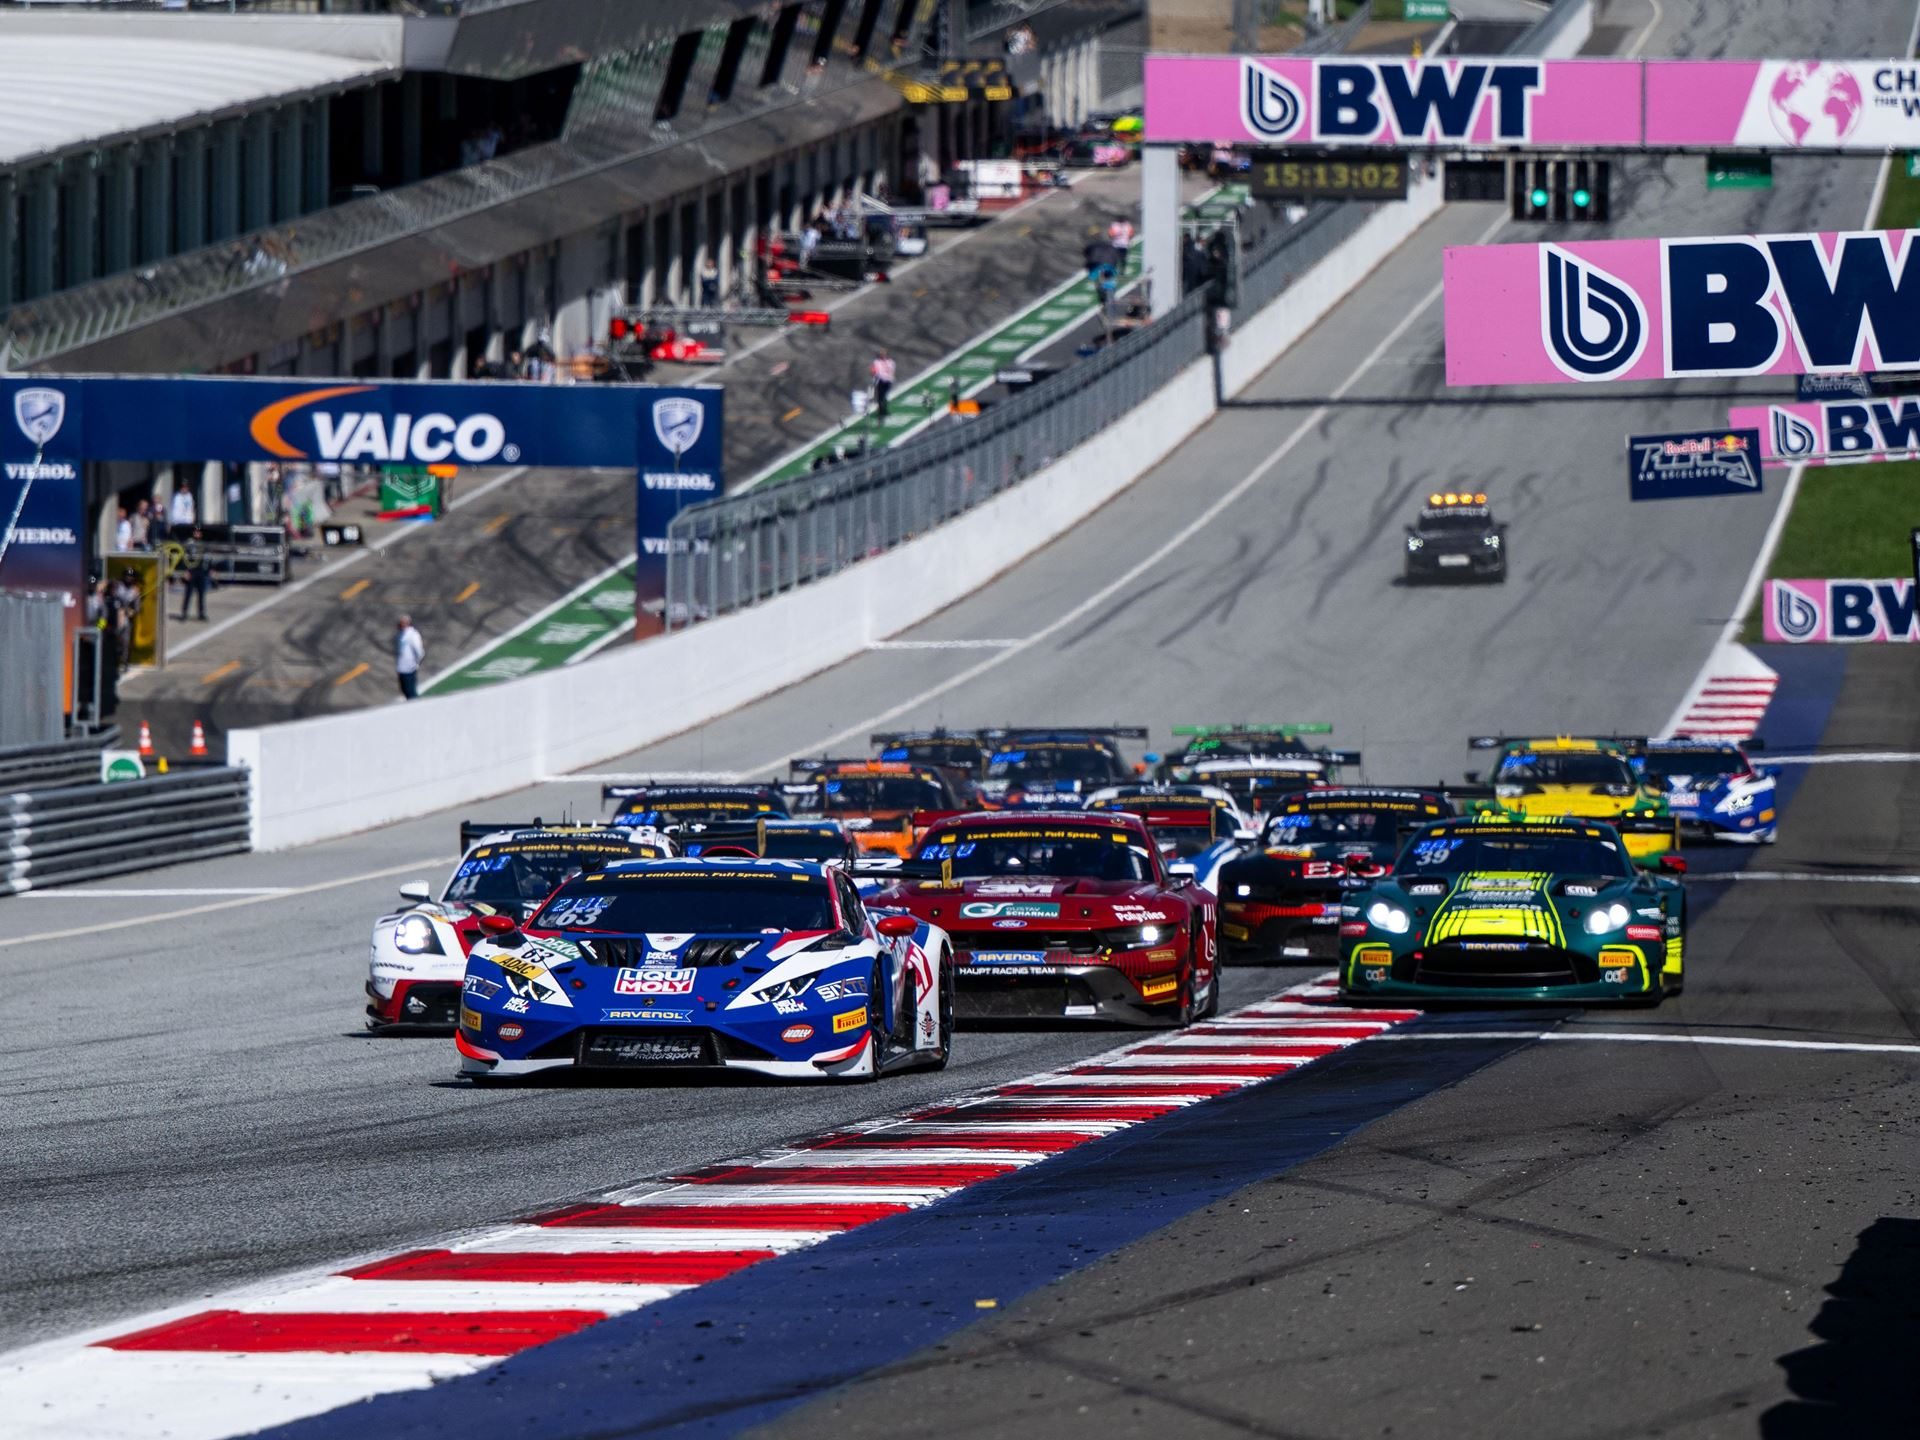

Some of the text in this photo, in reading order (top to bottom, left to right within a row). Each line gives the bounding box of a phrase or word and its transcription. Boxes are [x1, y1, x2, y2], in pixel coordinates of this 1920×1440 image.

[1873, 69, 1920, 92] CH
[1316, 61, 1543, 141] BWT
[1263, 163, 1400, 189] 15:13:02
[5, 464, 76, 480] VIEROL
[643, 473, 715, 490] VIEROL
[5, 528, 76, 544] VIEROL
[1415, 848, 1450, 866] 39
[736, 871, 777, 879] Speed.
[555, 907, 603, 925] 63
[520, 947, 555, 963] 63
[542, 937, 582, 959] DEKRA
[499, 956, 536, 974] ADAC
[977, 952, 1040, 962] RAVENOL
[622, 970, 691, 981] LIQUI
[959, 966, 1056, 975] HAUPT RACING TEAM
[619, 980, 691, 992] MOLY
[502, 1003, 531, 1014] PACK
[609, 1011, 683, 1019] RAVENOL
[777, 1002, 808, 1015] PACK
[837, 1011, 865, 1029] PIRELLI
[783, 1029, 812, 1038] HOLY
